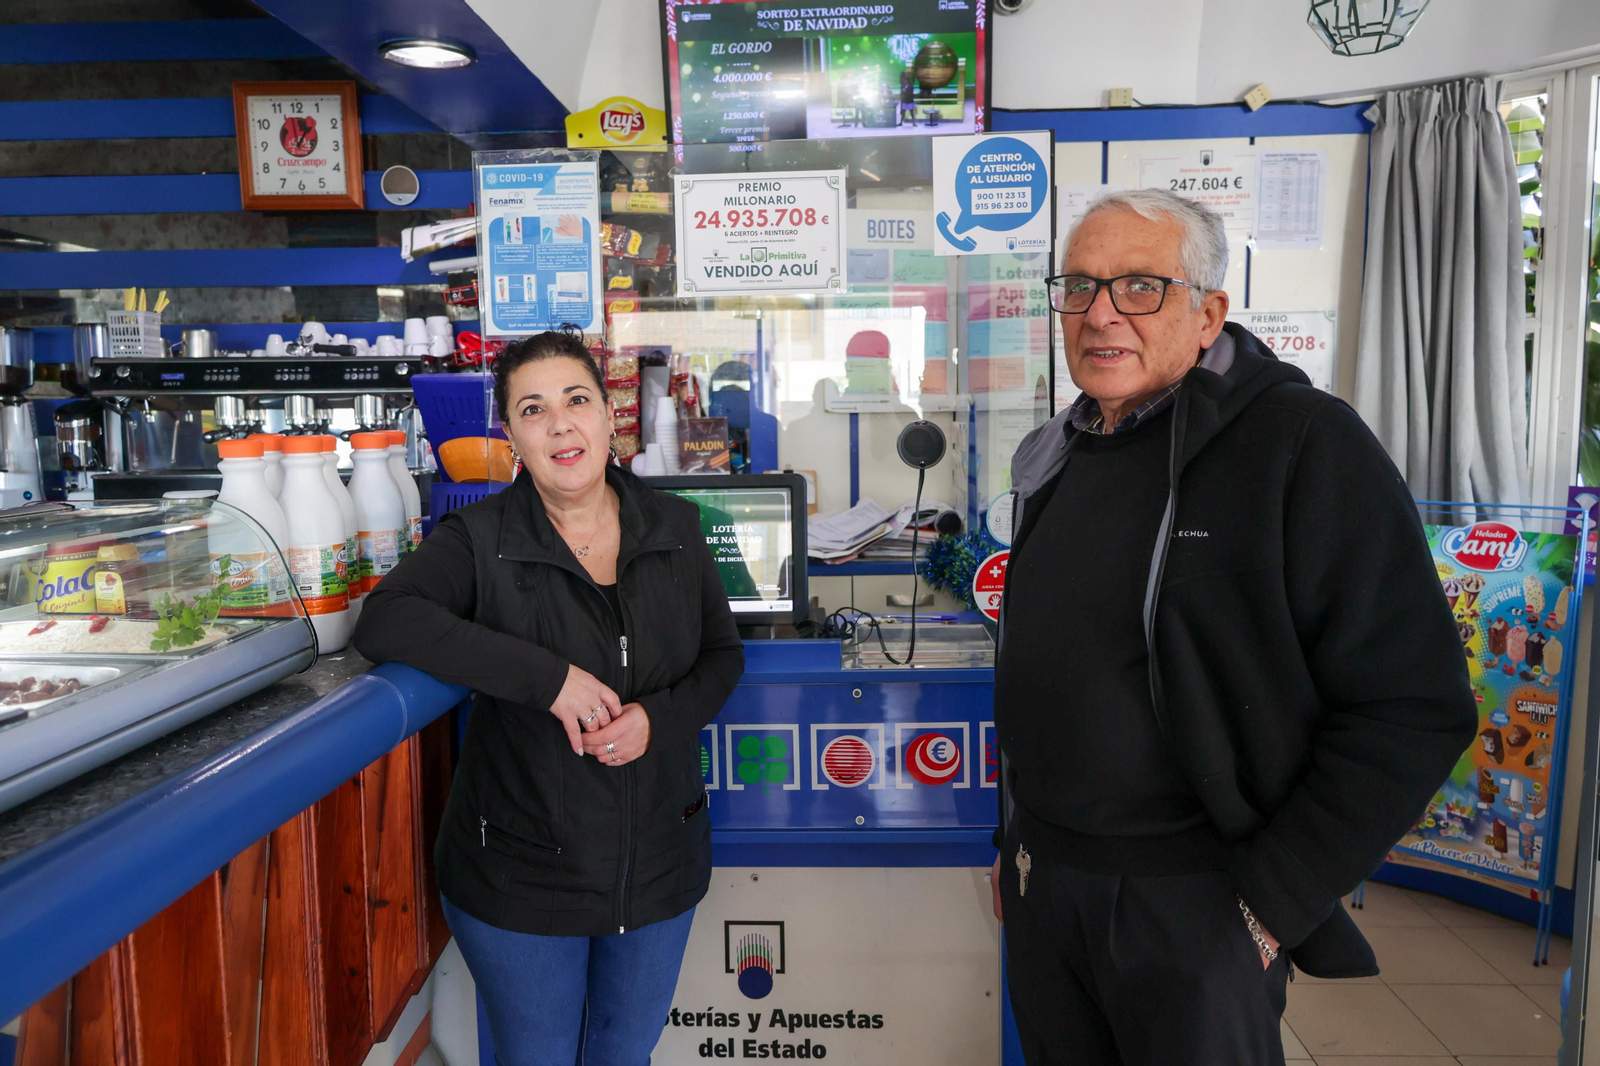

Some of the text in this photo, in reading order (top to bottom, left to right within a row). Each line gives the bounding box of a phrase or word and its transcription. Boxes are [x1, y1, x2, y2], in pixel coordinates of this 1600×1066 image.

[757, 5, 894, 19] SORTEO EXTRAORDINARIO
[783, 17, 868, 31] DE NAVIDAD
[711, 41, 772, 54] EL GORDO
[713, 72, 772, 83] 4.000.000 €
[711, 90, 745, 101] Segundo
[272, 102, 282, 114] 11
[290, 102, 303, 114] 12
[314, 102, 320, 113] 1
[257, 118, 270, 130] 10
[330, 118, 338, 129] 2
[720, 125, 770, 134] Tercer premio
[260, 141, 269, 152] 9
[332, 140, 340, 152] 3
[729, 144, 756, 152] 500.000
[277, 157, 327, 168] Cruzcampo
[980, 153, 1022, 163] CENTRO
[262, 162, 270, 174] 8
[332, 162, 341, 173] 4
[966, 161, 1036, 174] DE ATENCIÓN
[279, 177, 287, 189] 7
[318, 177, 326, 188] 5
[970, 173, 1032, 184] AL USUARIO
[1170, 176, 1243, 191] 247.604 €
[298, 180, 306, 191] 6
[738, 182, 782, 192] PREMIO
[489, 197, 524, 205] Fenamix
[723, 195, 796, 206] MILLONARIO
[976, 193, 994, 201] 900
[1017, 191, 1026, 199] 13
[974, 202, 989, 210] 915
[991, 202, 1002, 210] 96
[1003, 201, 1014, 209] 23
[694, 208, 830, 229] 24.935.708 €
[867, 219, 915, 239] BOTES
[740, 252, 807, 261] La Primitiva
[704, 260, 818, 278] VENDIDO AQUÍ
[1251, 314, 1288, 323] PREMIO
[684, 441, 725, 451] PALADIN
[712, 524, 753, 533] LOTERÍA
[721, 535, 763, 543] NAVIDAD
[1475, 530, 1508, 539] Helados
[1446, 530, 1524, 567] Camy
[49, 593, 86, 613] Original
[1482, 585, 1522, 613] SUPREME
[1516, 700, 1557, 715] SANDWICH
[1530, 712, 1548, 724] DUO
[1411, 841, 1514, 874] el Placer de Volver
[747, 1013, 761, 1033] y
[769, 1009, 884, 1033] Apuestas
[699, 1038, 827, 1059] del Estado
